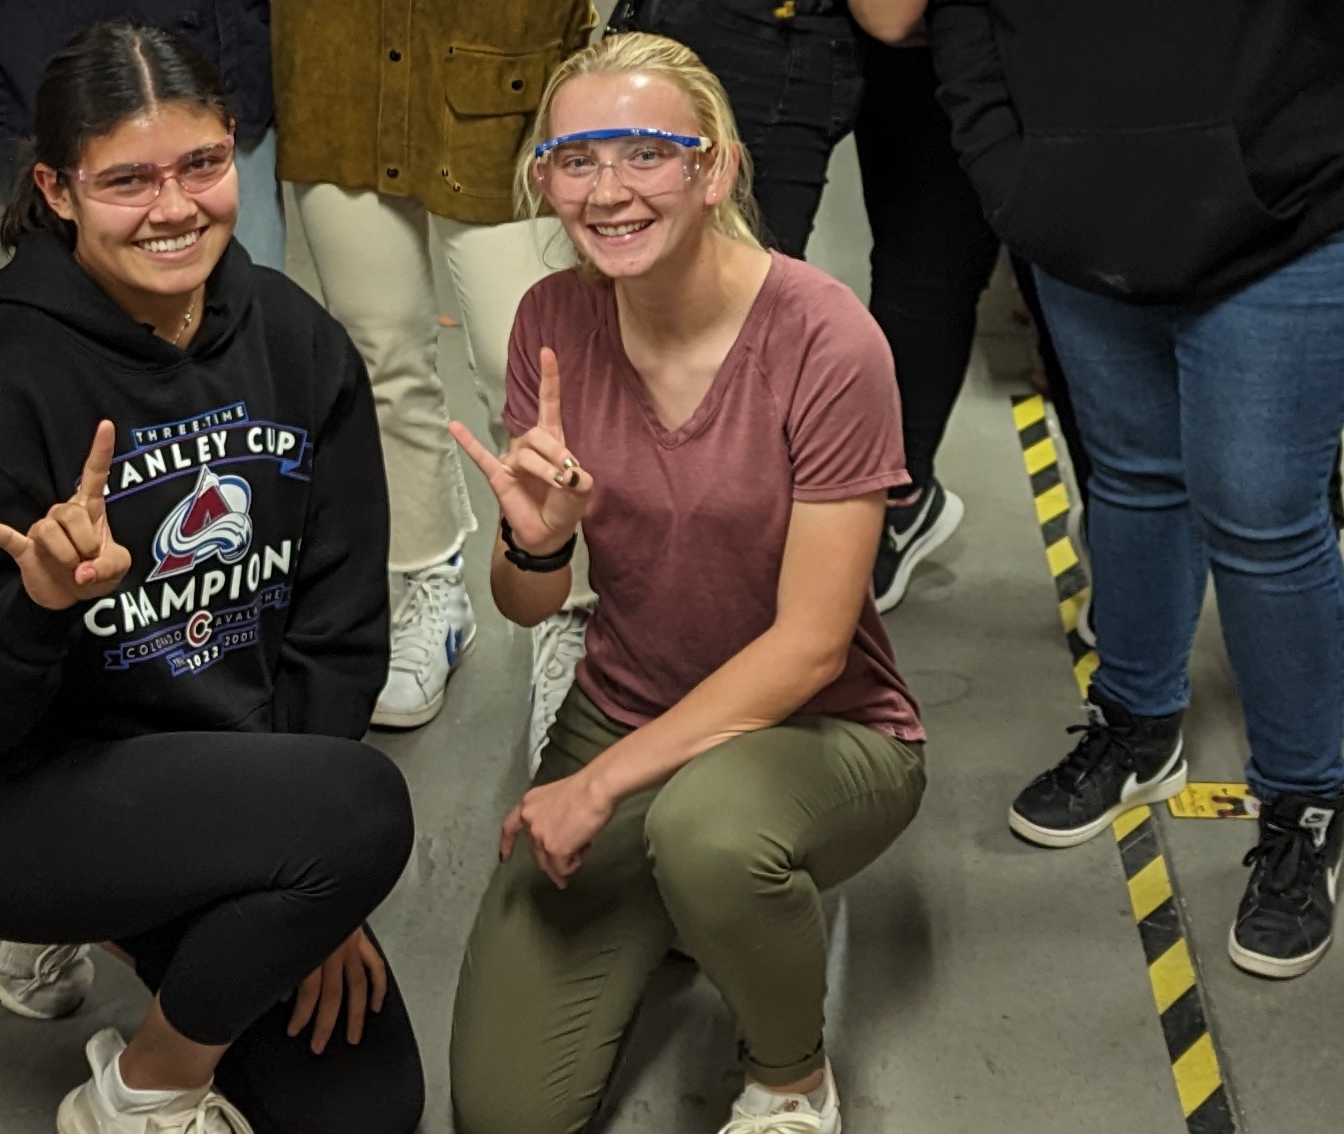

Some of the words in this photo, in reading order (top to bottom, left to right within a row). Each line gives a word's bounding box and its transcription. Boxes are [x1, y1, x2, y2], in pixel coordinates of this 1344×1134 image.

[103, 430, 228, 496] ANLEY
[247, 426, 295, 456] CUP
[84, 538, 302, 637] CHAMPION
